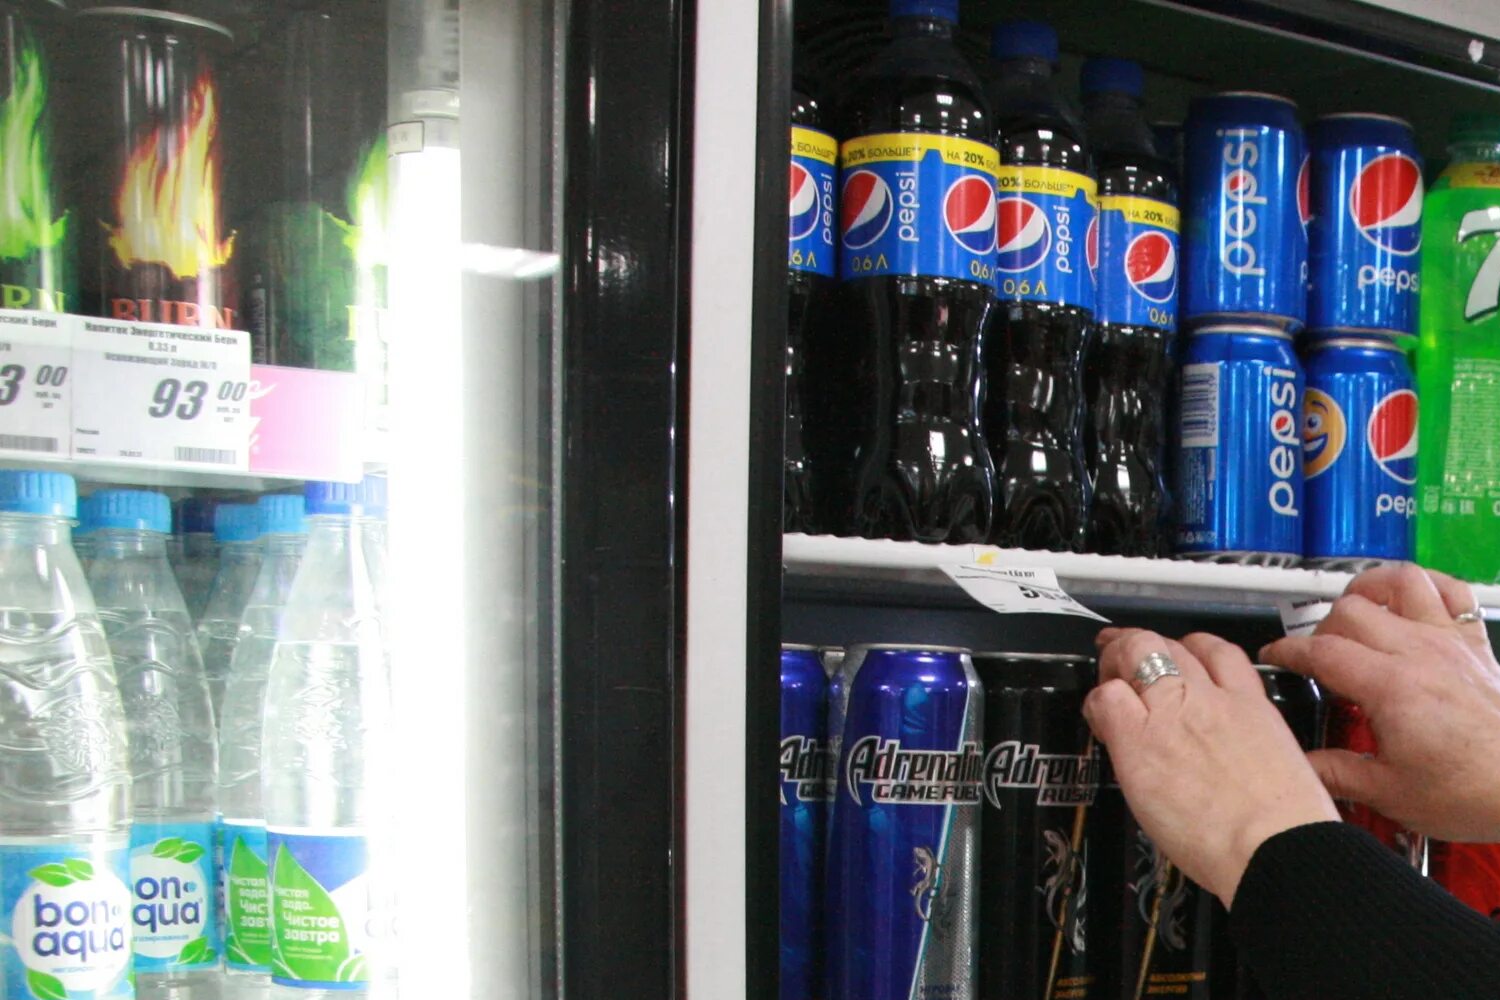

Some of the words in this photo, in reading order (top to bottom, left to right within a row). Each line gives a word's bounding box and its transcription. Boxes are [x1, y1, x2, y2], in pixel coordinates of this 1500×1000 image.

[946, 151, 960, 161] НА
[964, 152, 985, 166] 20%
[820, 173, 833, 246] pepsi
[896, 171, 920, 242] pepsi
[1144, 209, 1163, 223] 20%
[1216, 129, 1267, 275] pepsi
[1053, 205, 1072, 273] pepsi
[1358, 265, 1420, 294] peps
[0, 284, 66, 313] RN
[0, 364, 26, 406] 3
[36, 365, 67, 387] 00
[149, 378, 208, 420] 93
[217, 381, 247, 401] 00
[1263, 365, 1300, 517] pepsi
[1375, 492, 1417, 518] pep
[877, 784, 938, 800] GAME
[134, 876, 181, 900] on
[34, 893, 109, 928] bon
[133, 900, 200, 933] qua
[240, 900, 270, 914] Чист
[240, 915, 272, 928] завт
[283, 912, 339, 929] Чистое
[33, 927, 124, 962] aqua
[284, 929, 340, 945] завтра
